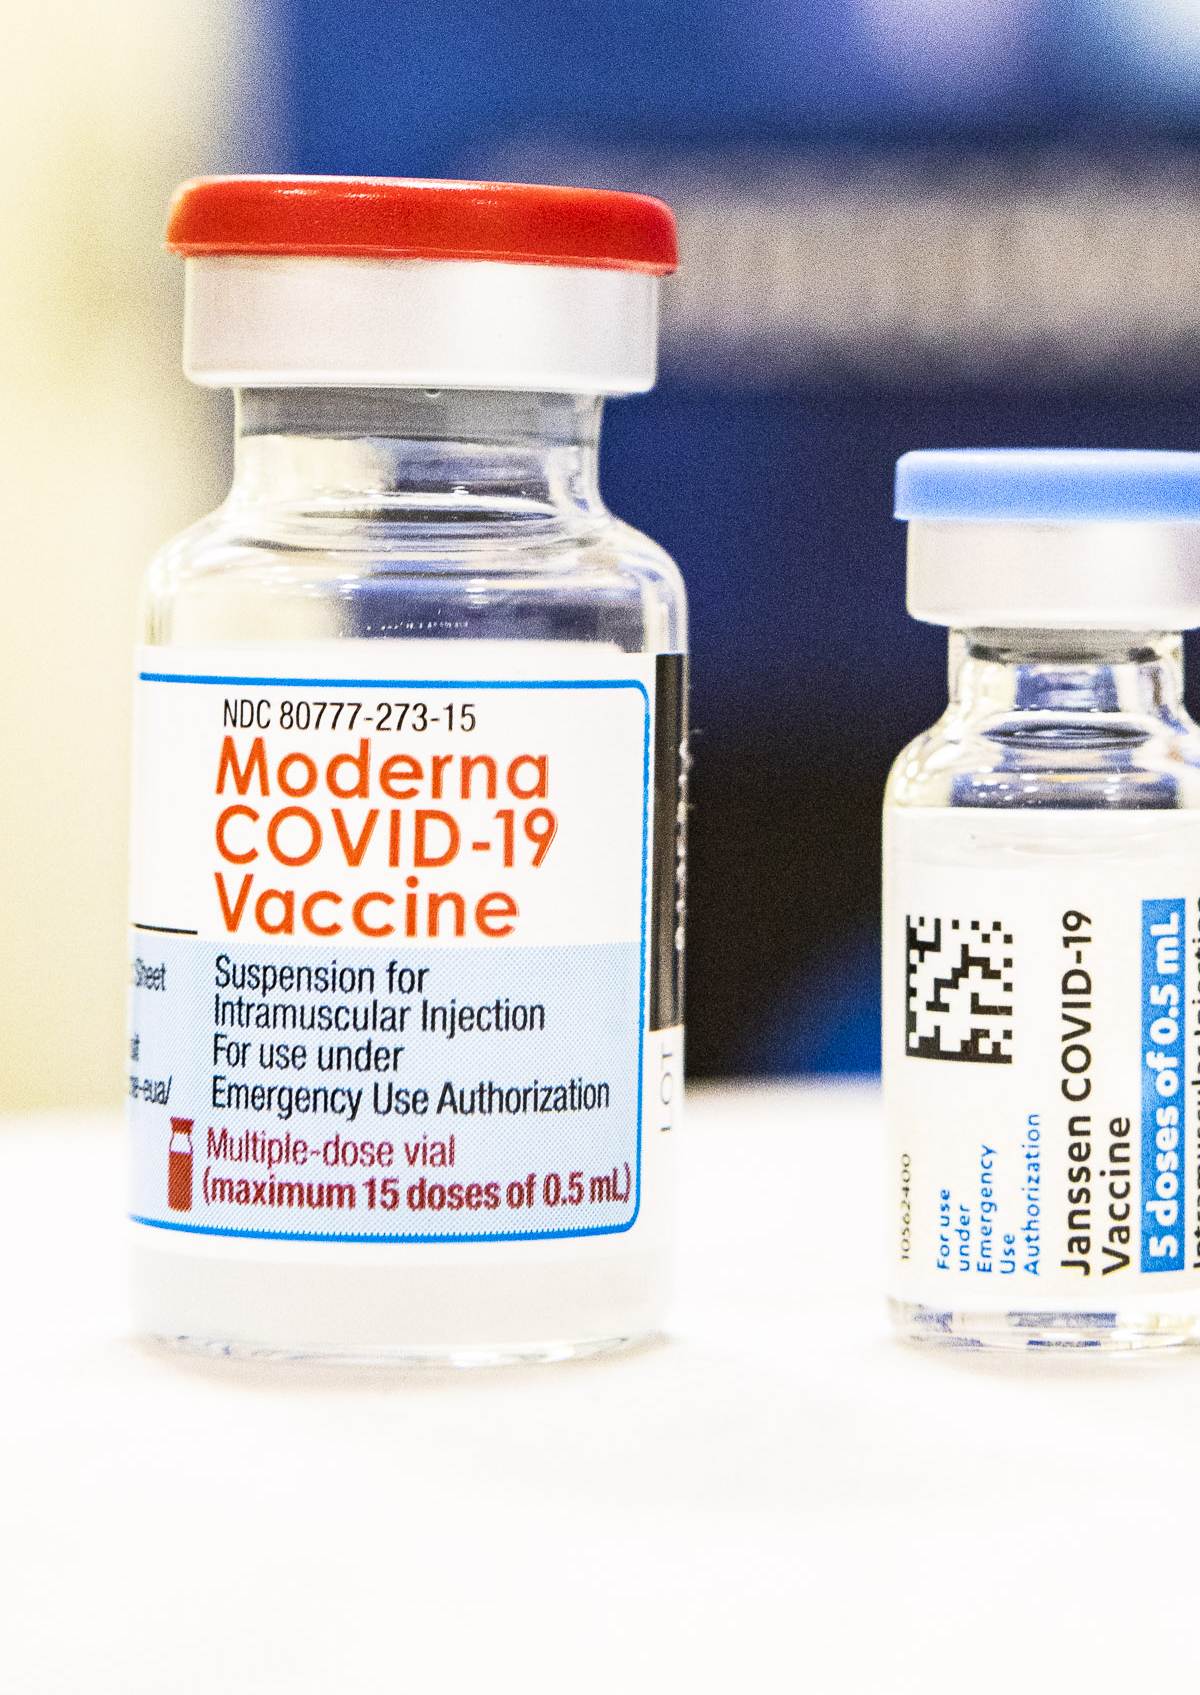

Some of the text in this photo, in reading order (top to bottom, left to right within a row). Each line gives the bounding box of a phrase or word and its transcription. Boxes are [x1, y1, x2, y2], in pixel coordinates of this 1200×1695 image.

[223, 699, 476, 732] NDC 80777-273-15
[215, 735, 548, 798] Moderna
[215, 805, 558, 867] COVID-19
[214, 872, 519, 936] Vaccine
[215, 955, 429, 996] Suspension for
[214, 994, 546, 1037] Intramuscular Injection
[213, 1034, 403, 1072] For use under
[212, 1075, 610, 1121] Emergency Use Authorization
[1061, 910, 1092, 1276] Janssen COVID-19
[1146, 912, 1180, 1258] 5 doses of 0.5 mL
[207, 1126, 455, 1174] Multiple-dose vial
[203, 1161, 630, 1211] (maximum 15 doses of 0.5 mL)
[978, 1145, 997, 1273] Emergency
[1022, 1113, 1040, 1276] Authorization
[1100, 1117, 1130, 1276] Vaccine
[937, 1188, 950, 1270] For use
[955, 1203, 970, 1272] under
[1001, 1233, 1015, 1274] Use
